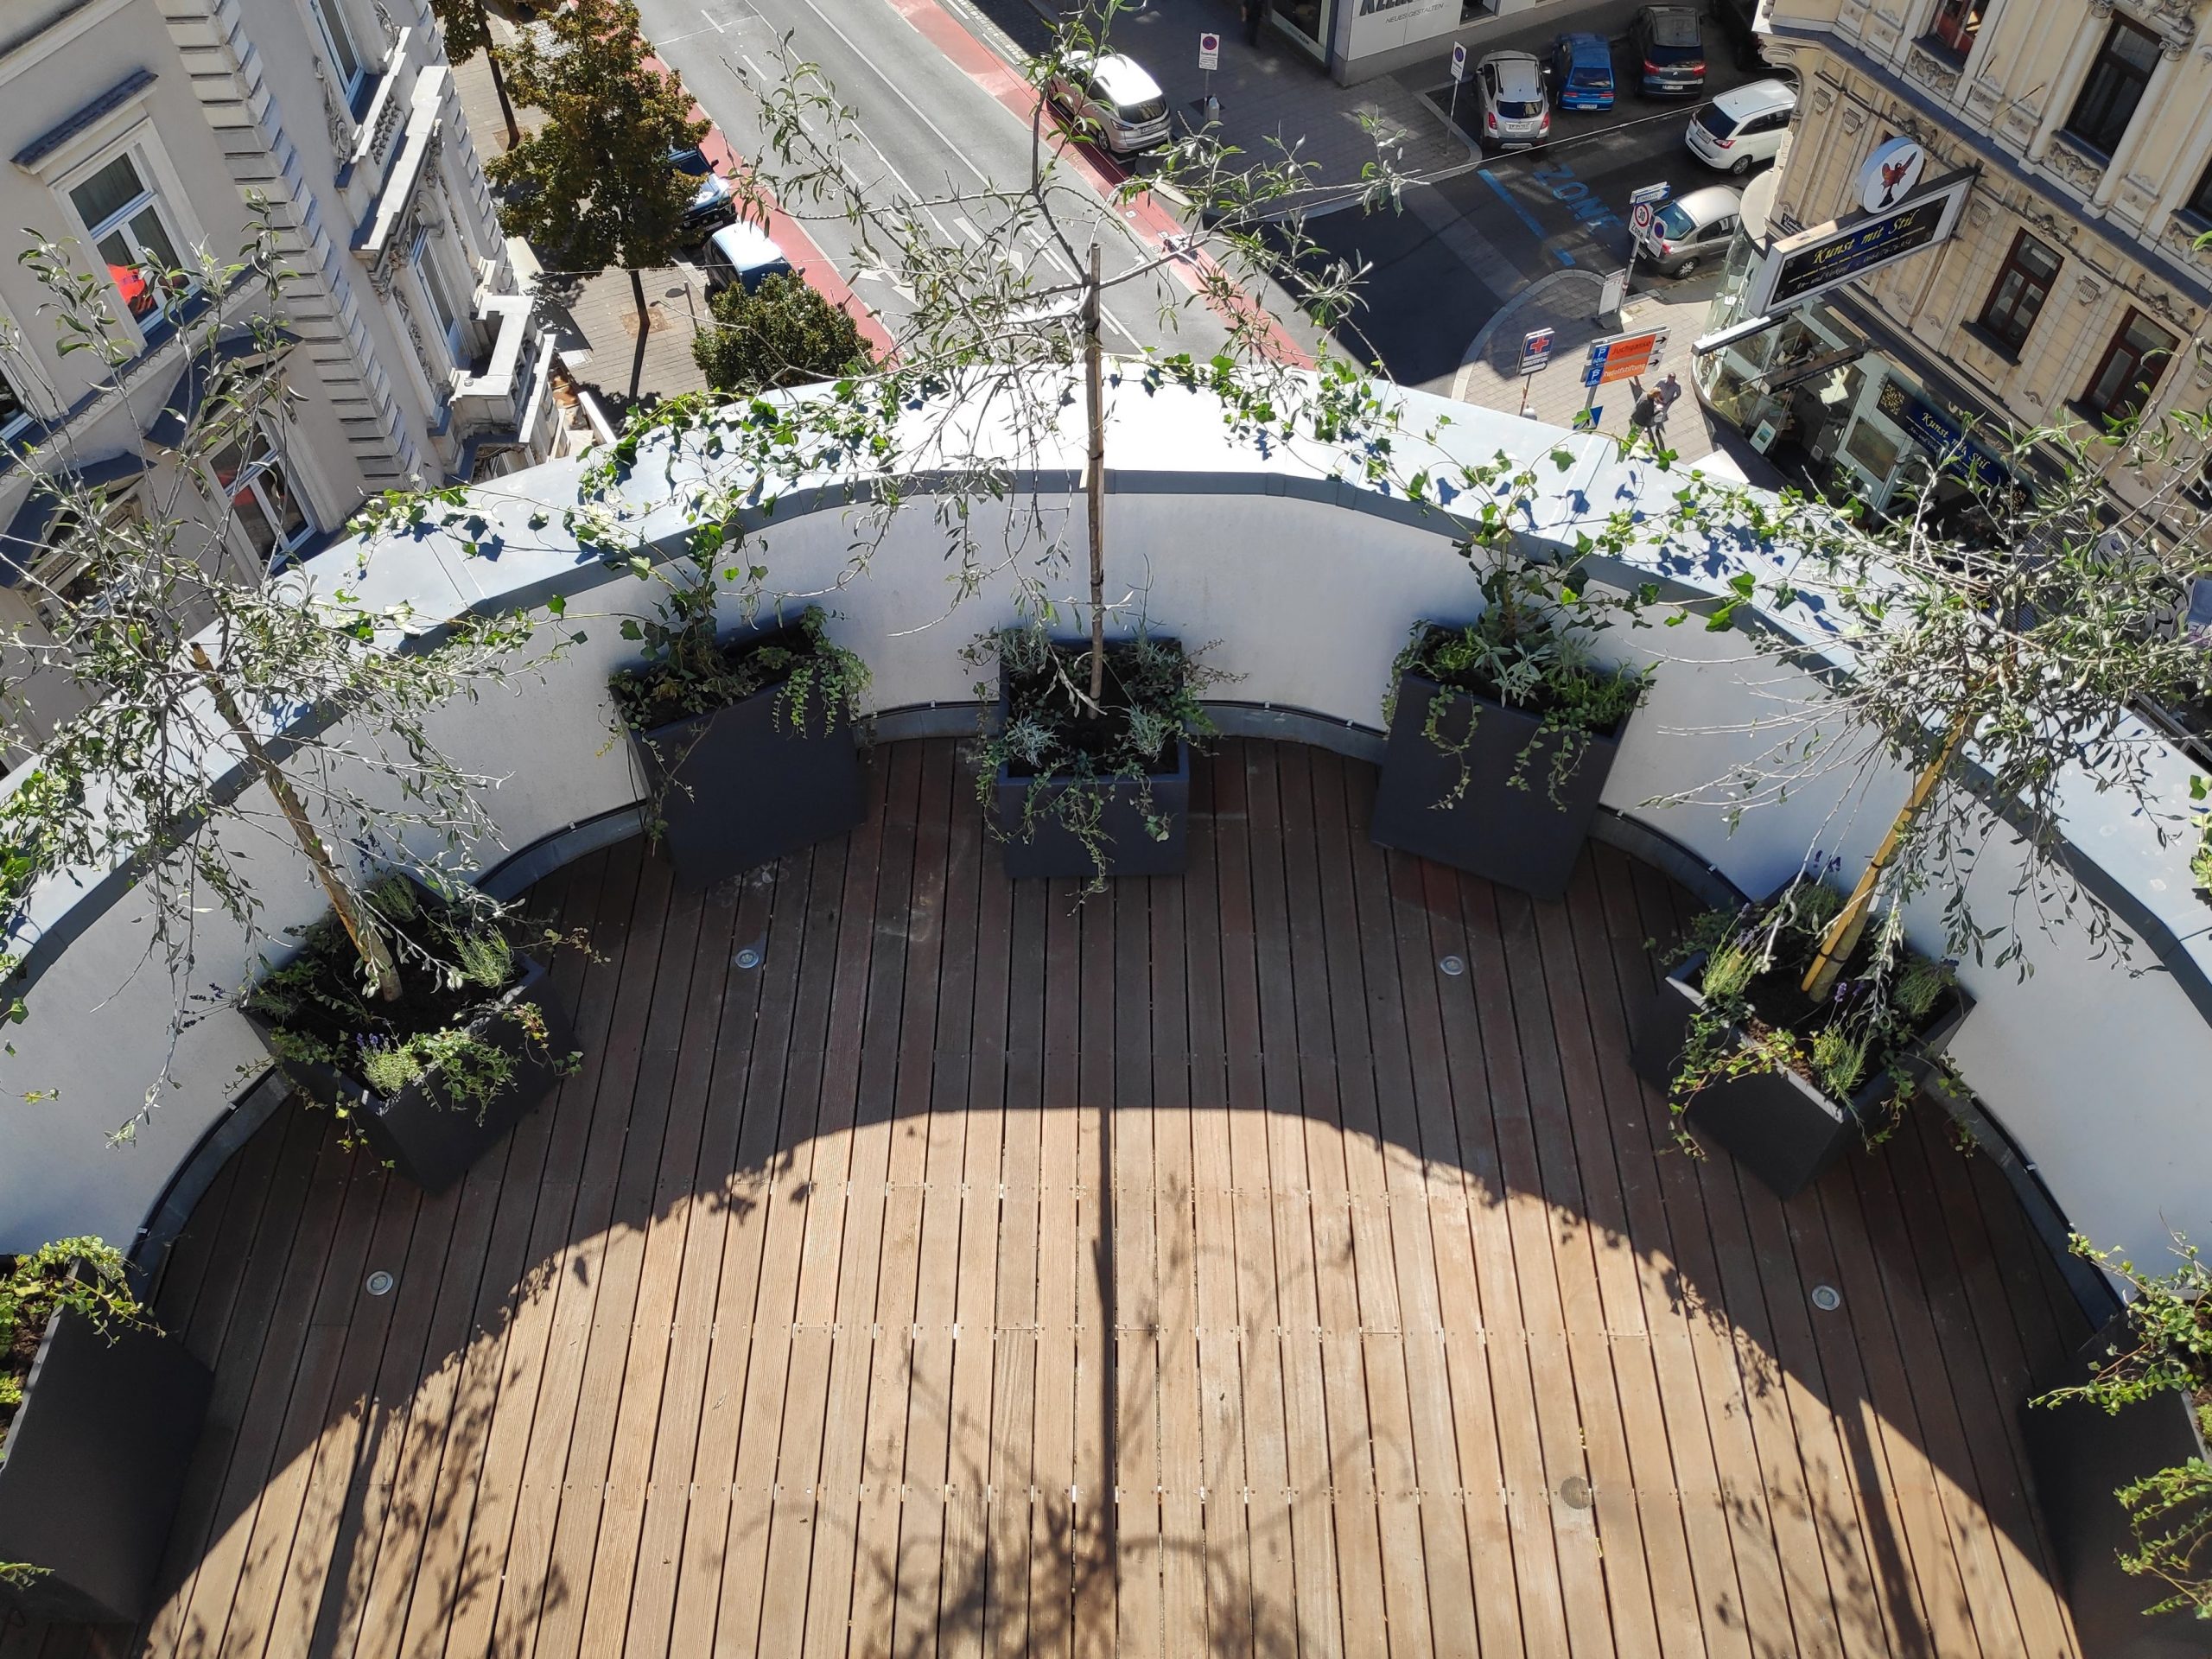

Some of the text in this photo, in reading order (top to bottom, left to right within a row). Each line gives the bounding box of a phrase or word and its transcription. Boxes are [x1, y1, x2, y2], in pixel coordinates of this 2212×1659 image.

[1385, 3, 1444, 23] NEUES GESTALTEN
[1534, 162, 1624, 234] ZONE
[1638, 209, 1645, 221] 30
[1631, 223, 1643, 239] Zone
[1812, 239, 1855, 264] Kunst
[1861, 226, 1885, 245] mit
[1888, 208, 1920, 235] Stil
[1612, 340, 1651, 355] Juchgasse
[1922, 412, 1948, 439] Kunst
[1968, 452, 1990, 470] Stil
